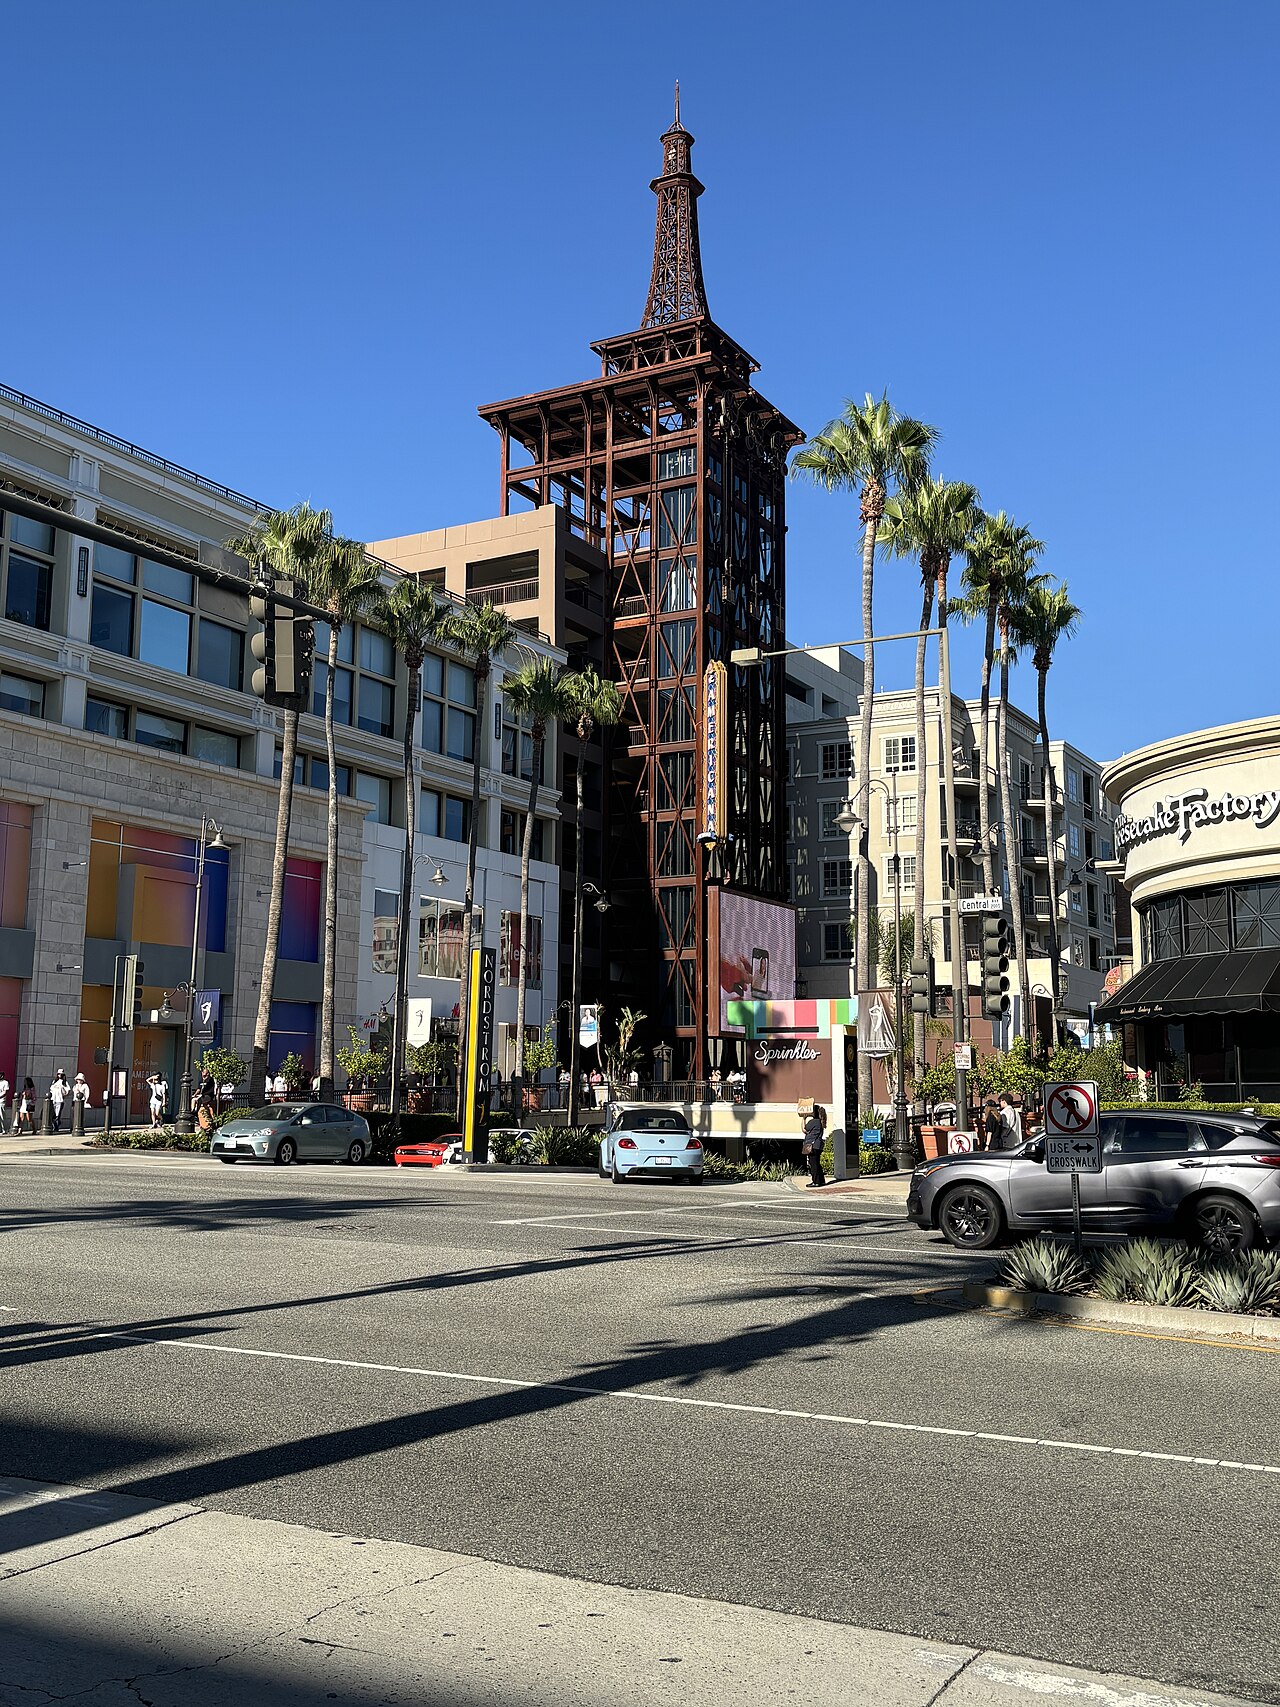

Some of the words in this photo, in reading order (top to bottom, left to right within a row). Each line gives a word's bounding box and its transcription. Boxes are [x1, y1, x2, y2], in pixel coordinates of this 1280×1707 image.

[707, 691, 716, 832] AMERICANA
[1165, 788, 1280, 845] Factory
[962, 900, 989, 910] Central
[479, 954, 494, 1092] NORDSTROM
[754, 1040, 820, 1066] Sprinkles
[1050, 1143, 1069, 1153] USE
[1050, 1156, 1098, 1168] CROSSWALK
